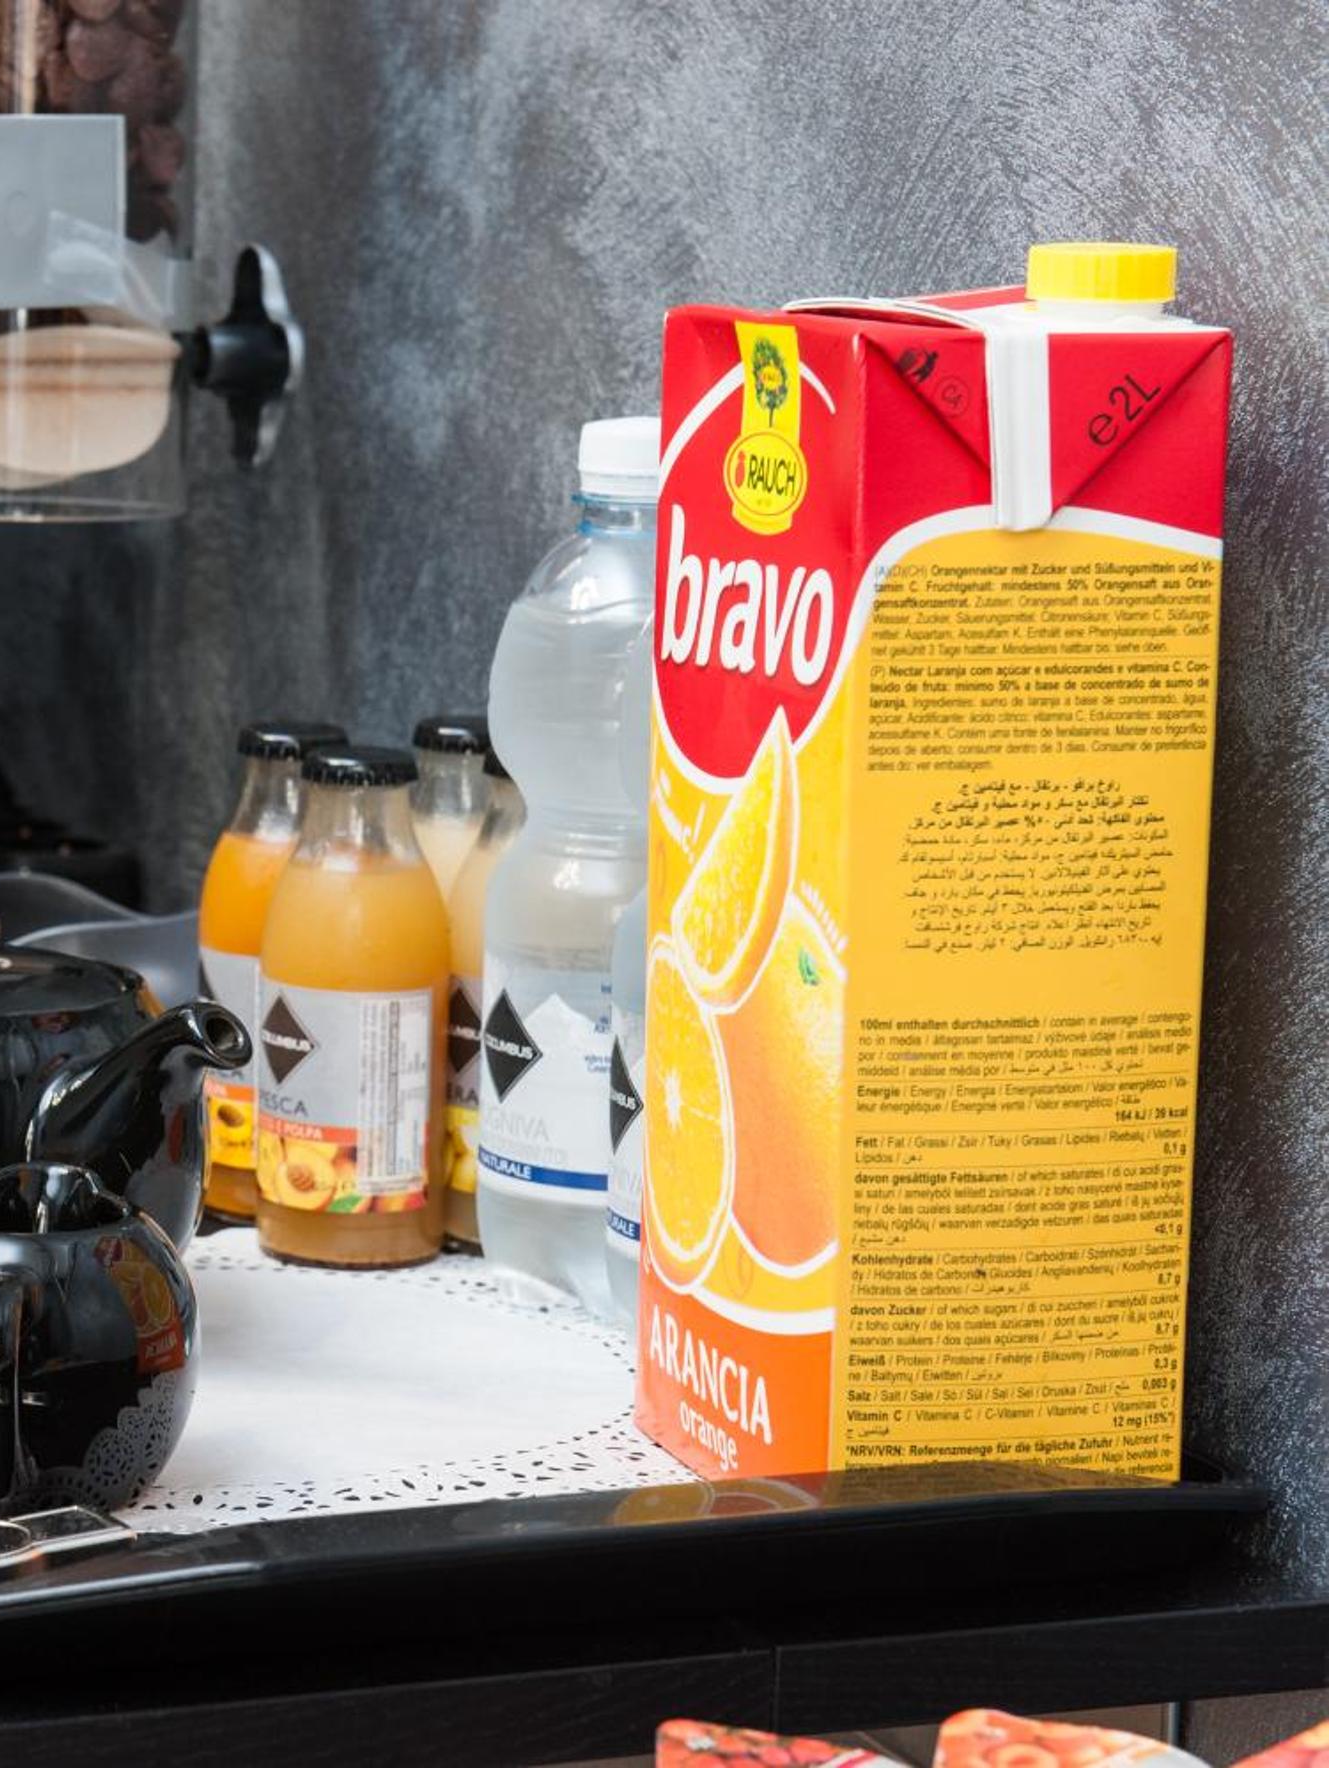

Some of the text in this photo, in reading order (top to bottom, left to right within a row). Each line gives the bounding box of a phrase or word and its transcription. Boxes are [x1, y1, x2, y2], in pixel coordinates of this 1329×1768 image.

[748, 454, 797, 497] RAUCH
[661, 503, 834, 686] bravo
[857, 1085, 900, 1099] Energie
[855, 1136, 878, 1148] Fett
[650, 1304, 773, 1446] ARANCIA
[847, 1390, 871, 1401] Salz
[846, 1409, 888, 1421] Vitamin
[680, 1400, 739, 1472] orange
